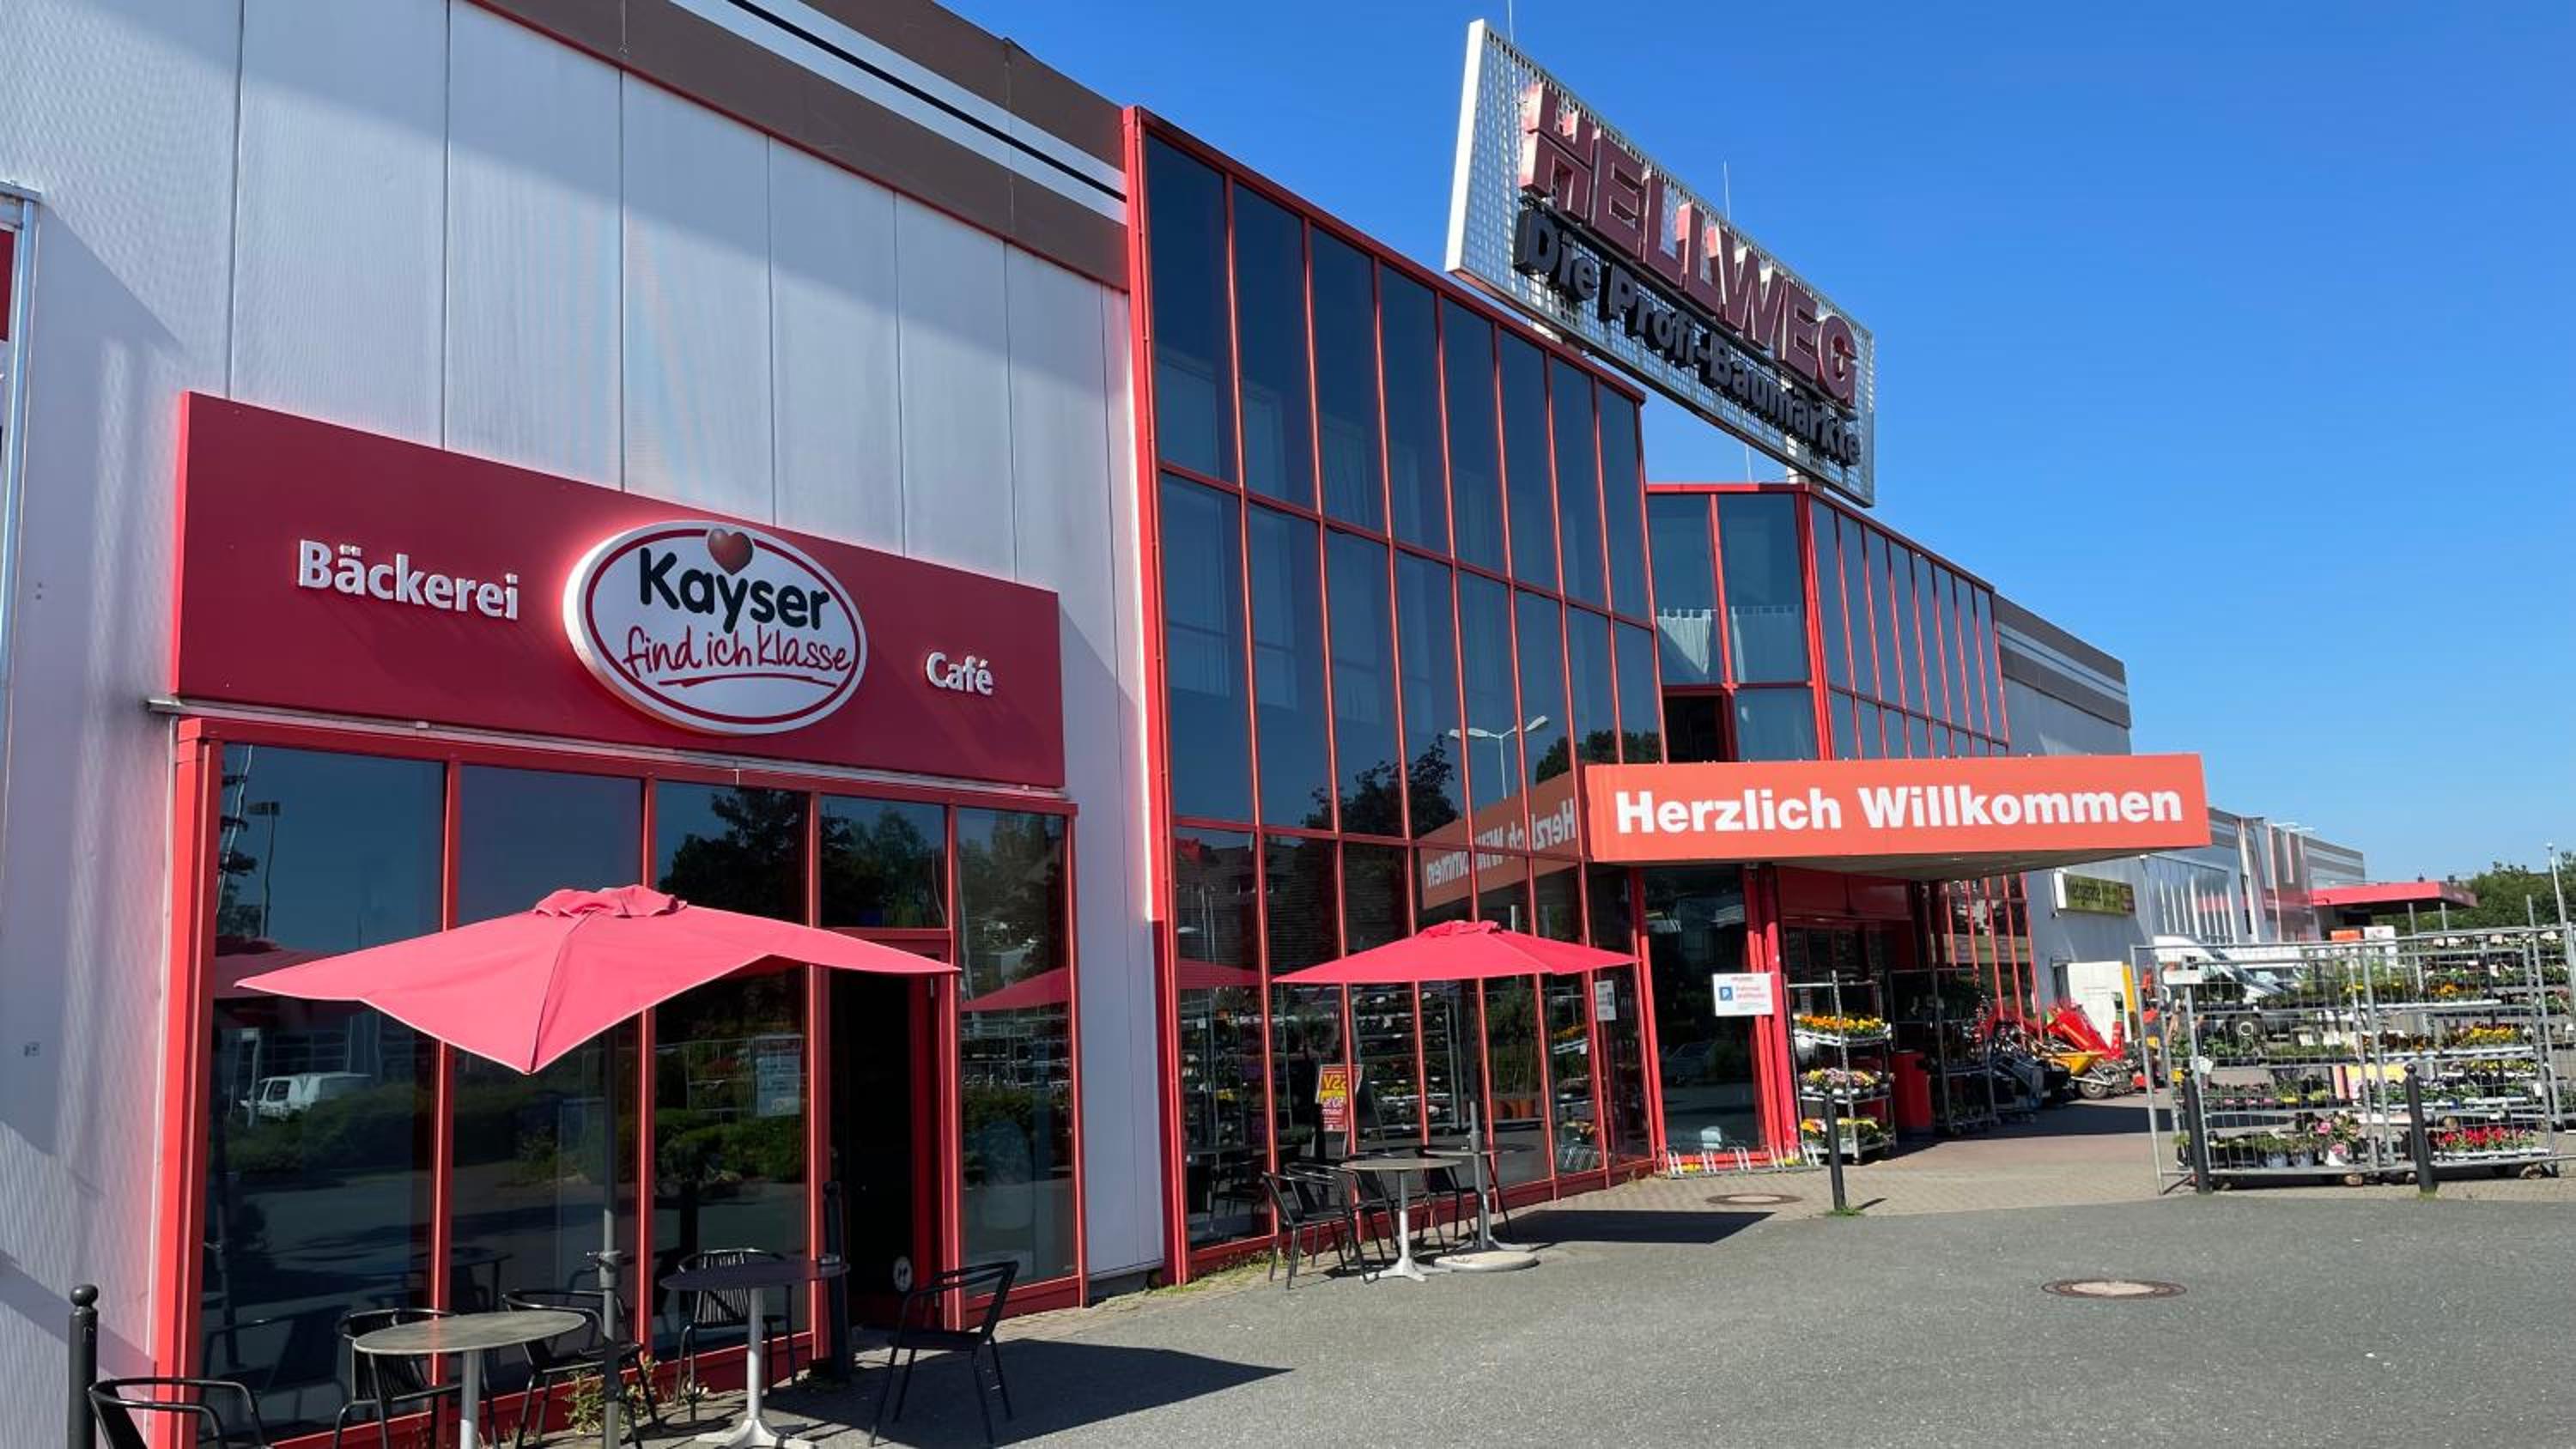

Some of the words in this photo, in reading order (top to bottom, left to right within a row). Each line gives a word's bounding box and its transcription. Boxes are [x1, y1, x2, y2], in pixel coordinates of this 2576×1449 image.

[1516, 210, 1599, 300] Die
[1519, 83, 1858, 409] HELLWEG
[299, 539, 518, 621] Bäckerei
[640, 547, 830, 634] Kayser
[623, 625, 702, 678] find
[707, 630, 752, 667] ich
[927, 652, 993, 696] Café
[1615, 788, 1842, 834] Herzlich
[1857, 785, 2184, 828] Willkommen
